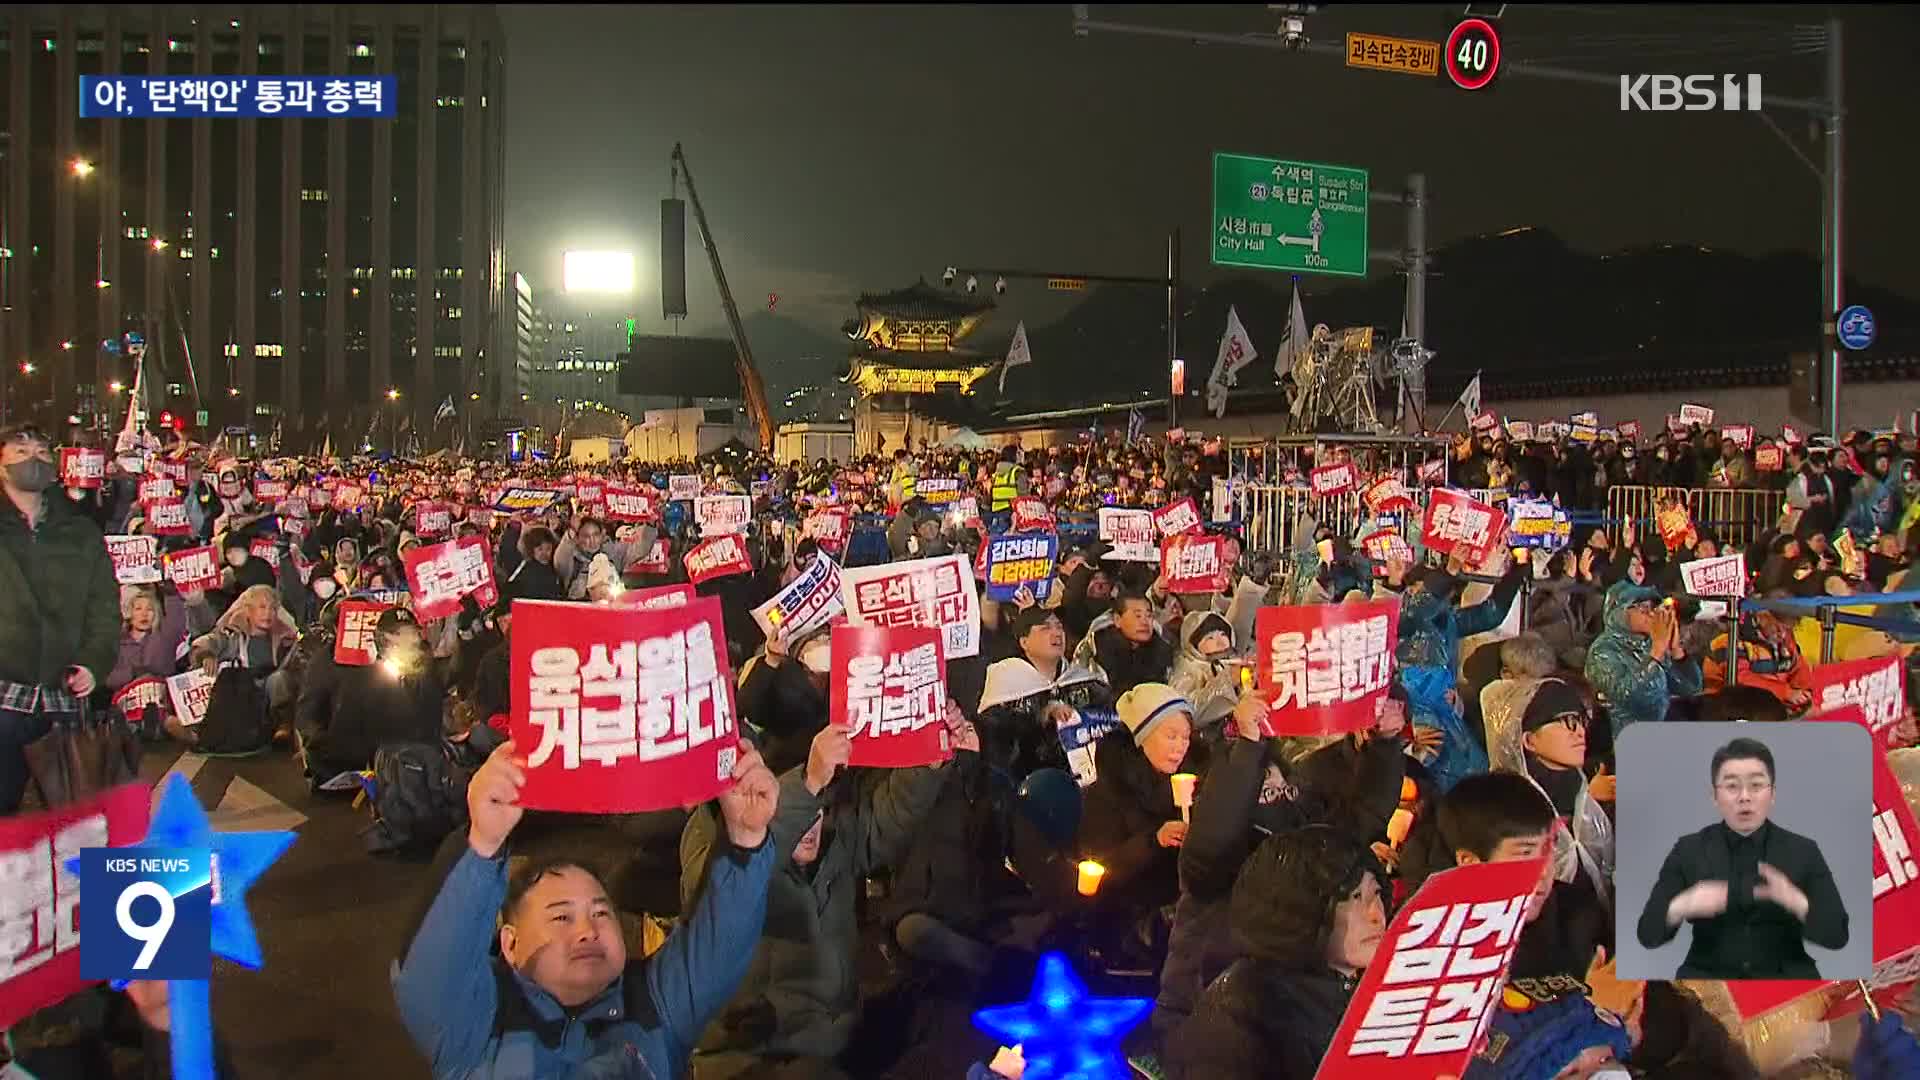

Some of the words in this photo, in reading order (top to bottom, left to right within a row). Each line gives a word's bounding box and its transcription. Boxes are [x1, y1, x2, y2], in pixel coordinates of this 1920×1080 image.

[1351, 40, 1435, 69] 과속단속장비
[1457, 39, 1487, 71] 40
[1272, 165, 1313, 184] 수색역
[1253, 185, 1267, 197] 21
[1272, 185, 1313, 206] 독립문
[1219, 216, 1246, 235] 시청
[1219, 236, 1241, 251] City
[1245, 239, 1264, 251] Hall
[1304, 254, 1328, 267] 100m
[1271, 650, 1390, 710] 거부한다!
[527, 675, 732, 770] 거부한다!
[846, 680, 946, 739] 거부한다!
[1383, 895, 1531, 984] 김건
[1347, 976, 1499, 1058] 특검
